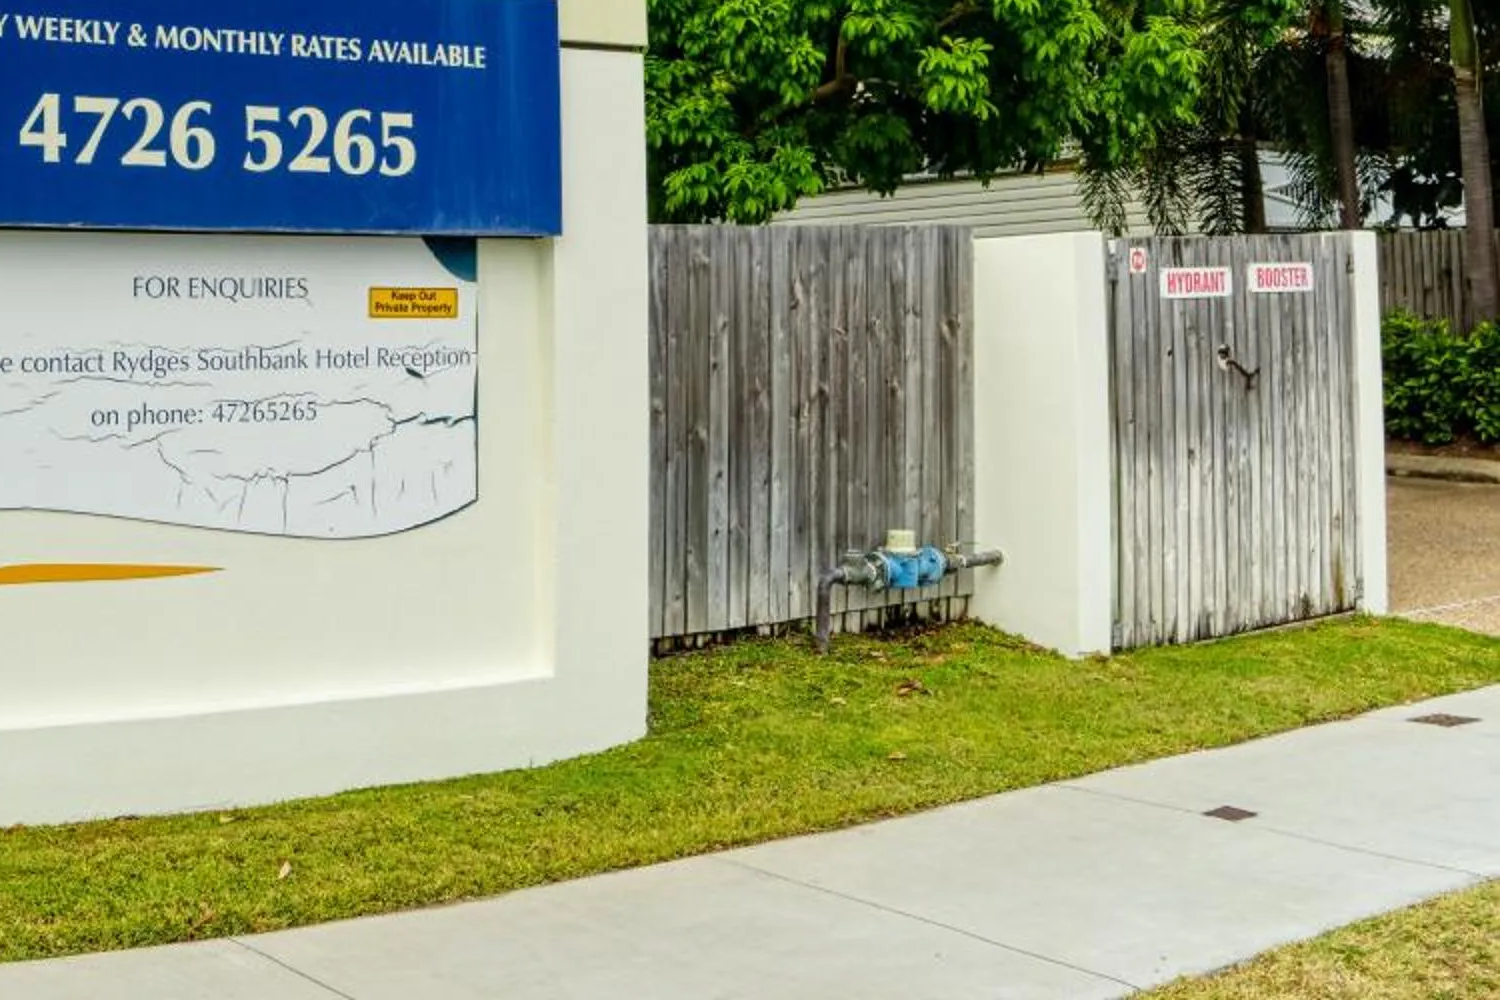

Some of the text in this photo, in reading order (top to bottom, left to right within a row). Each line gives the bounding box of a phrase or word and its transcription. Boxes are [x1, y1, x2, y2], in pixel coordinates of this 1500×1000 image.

[15, 15, 120, 46] WEEKLY
[127, 23, 148, 48] &
[155, 25, 285, 57] MONTHLY
[290, 34, 362, 62] RATES
[368, 39, 487, 69] AVAILABLE
[19, 93, 417, 177] 4726 5265
[133, 276, 310, 301] FOR ENQUIRIES
[1167, 271, 1226, 294] HYDRANT
[1256, 266, 1309, 288] BOOSTER
[391, 290, 437, 302] Keep Out
[375, 302, 453, 316] Private Property
[20, 351, 105, 373] contact
[111, 350, 190, 379] Rydges
[196, 346, 309, 372] Southbank
[315, 347, 370, 369] Hotel
[377, 346, 472, 372] Reception
[90, 401, 319, 432] on phone: 47265265
